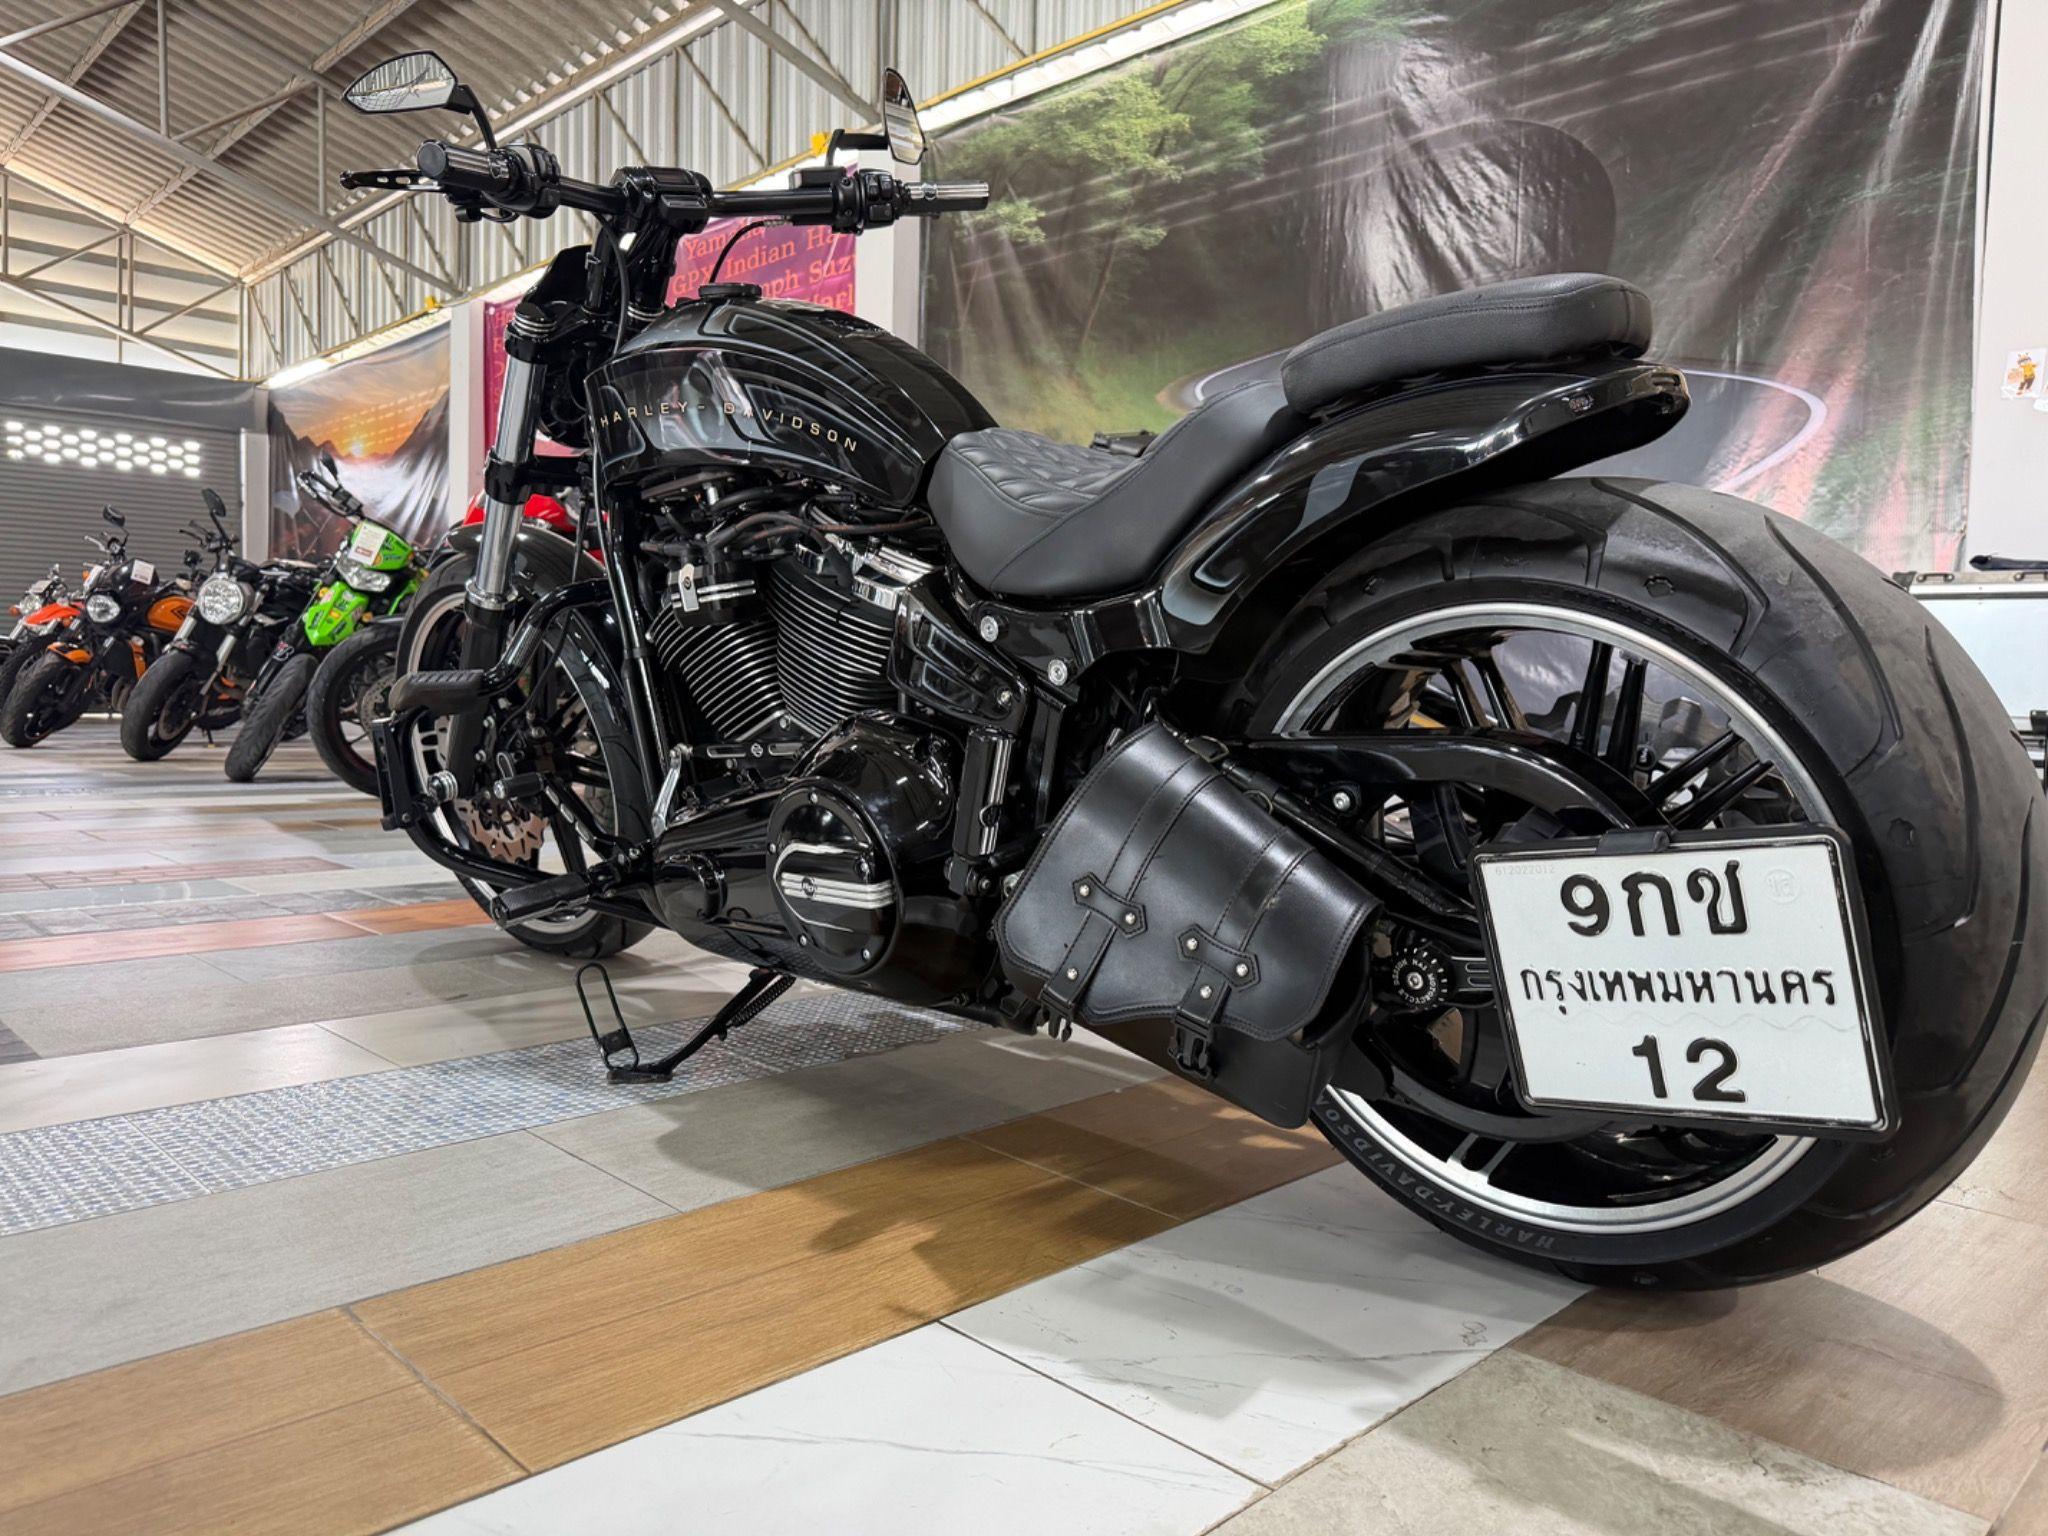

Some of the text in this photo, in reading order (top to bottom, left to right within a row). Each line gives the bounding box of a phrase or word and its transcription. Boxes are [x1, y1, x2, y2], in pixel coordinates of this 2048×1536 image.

[725, 239, 797, 280] Indian
[1519, 967, 1836, 1016] กรุงเทพมหานคร
[1631, 1034, 1747, 1103] 12
